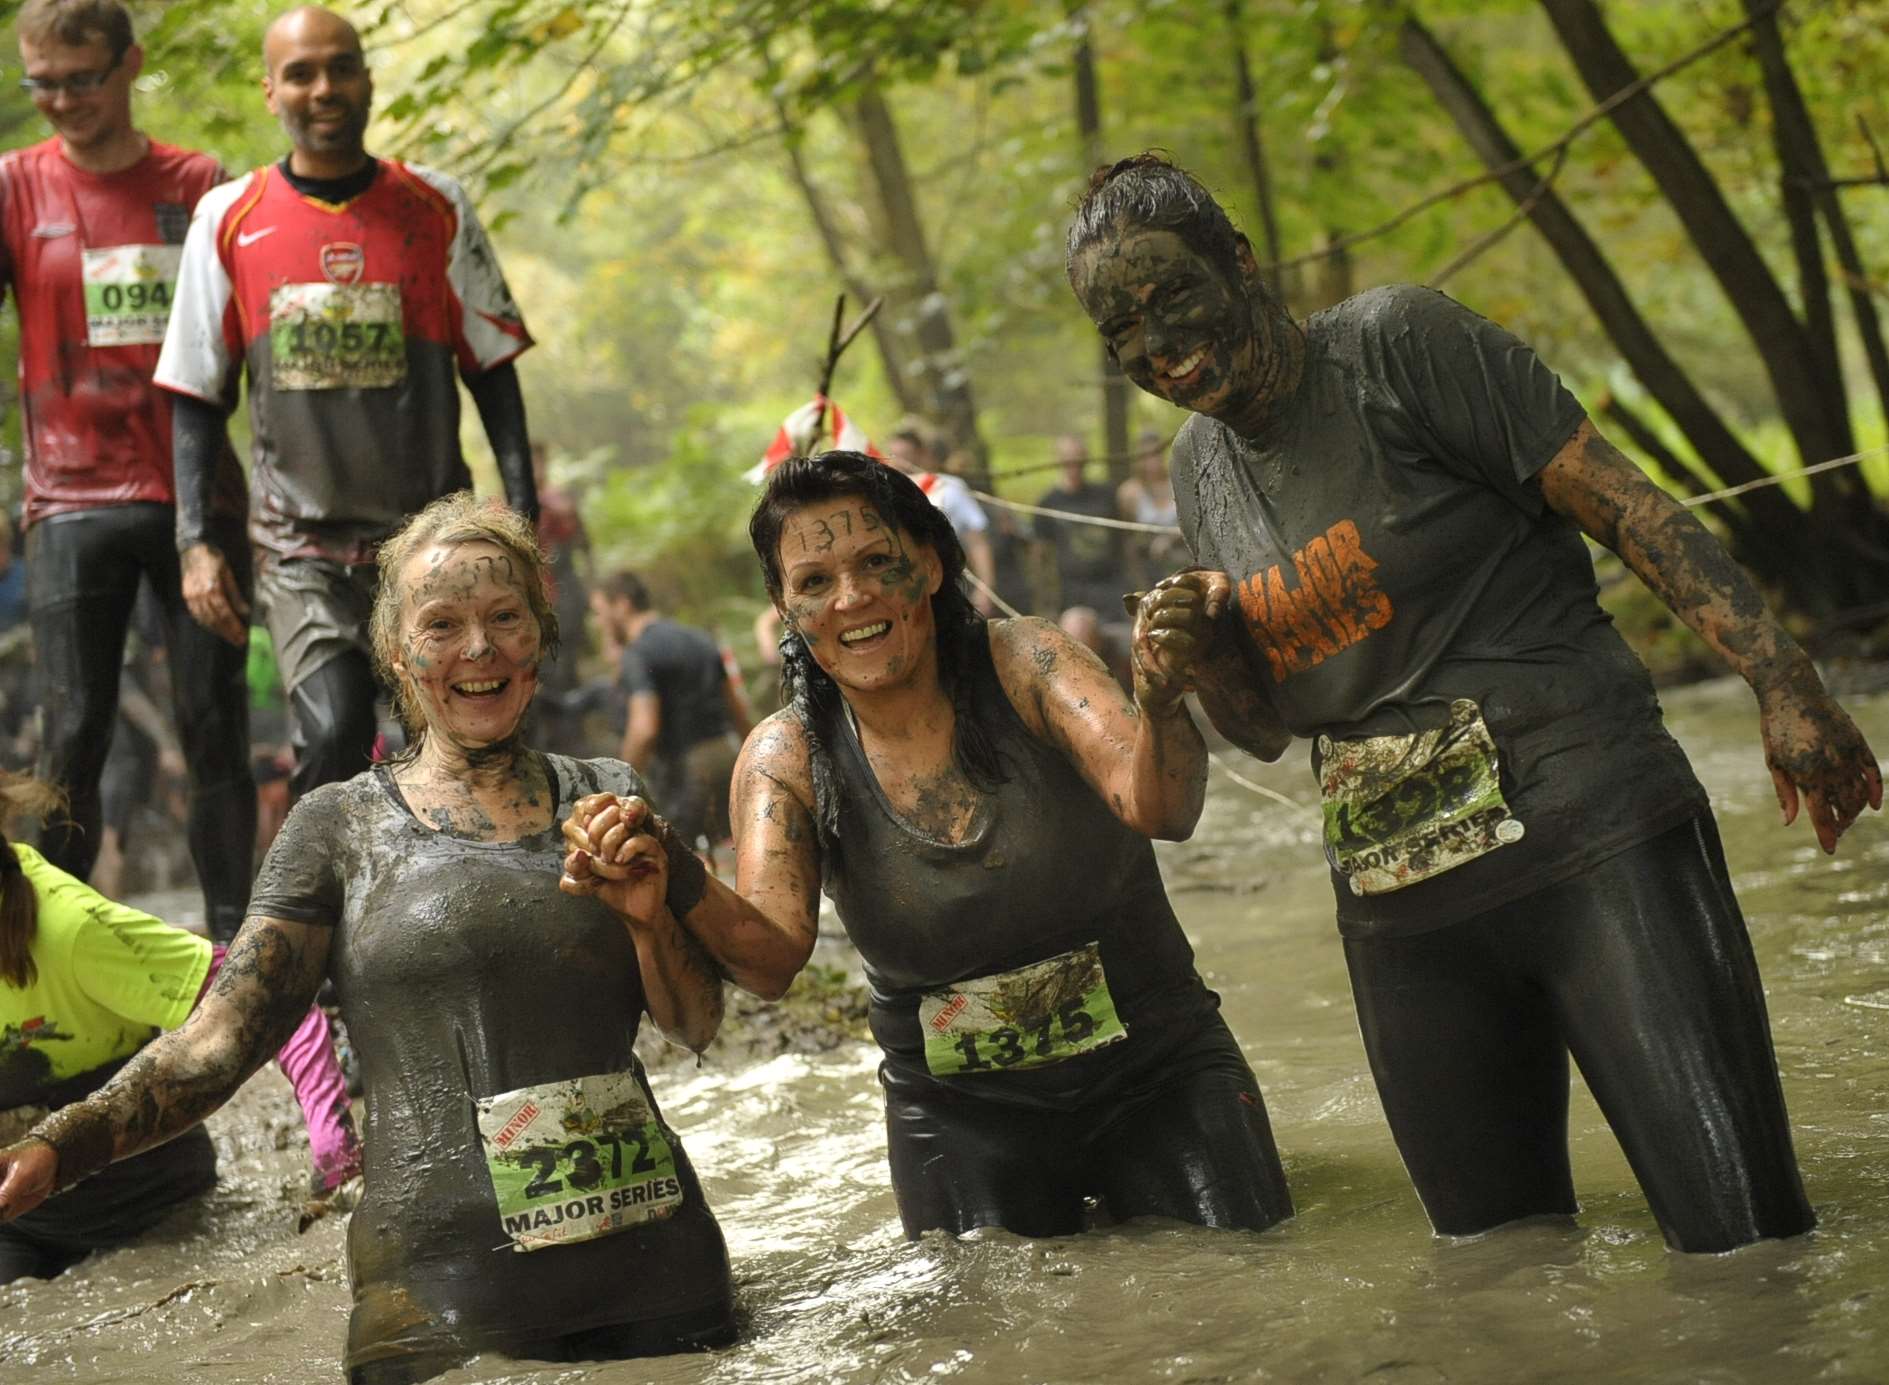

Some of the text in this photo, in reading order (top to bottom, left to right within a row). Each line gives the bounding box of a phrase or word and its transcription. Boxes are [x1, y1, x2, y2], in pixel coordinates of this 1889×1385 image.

[496, 1103, 539, 1148] MINOR
[520, 1131, 656, 1200] 2372
[504, 1196, 604, 1235] MAJOR
[610, 1178, 680, 1210] SERIES
